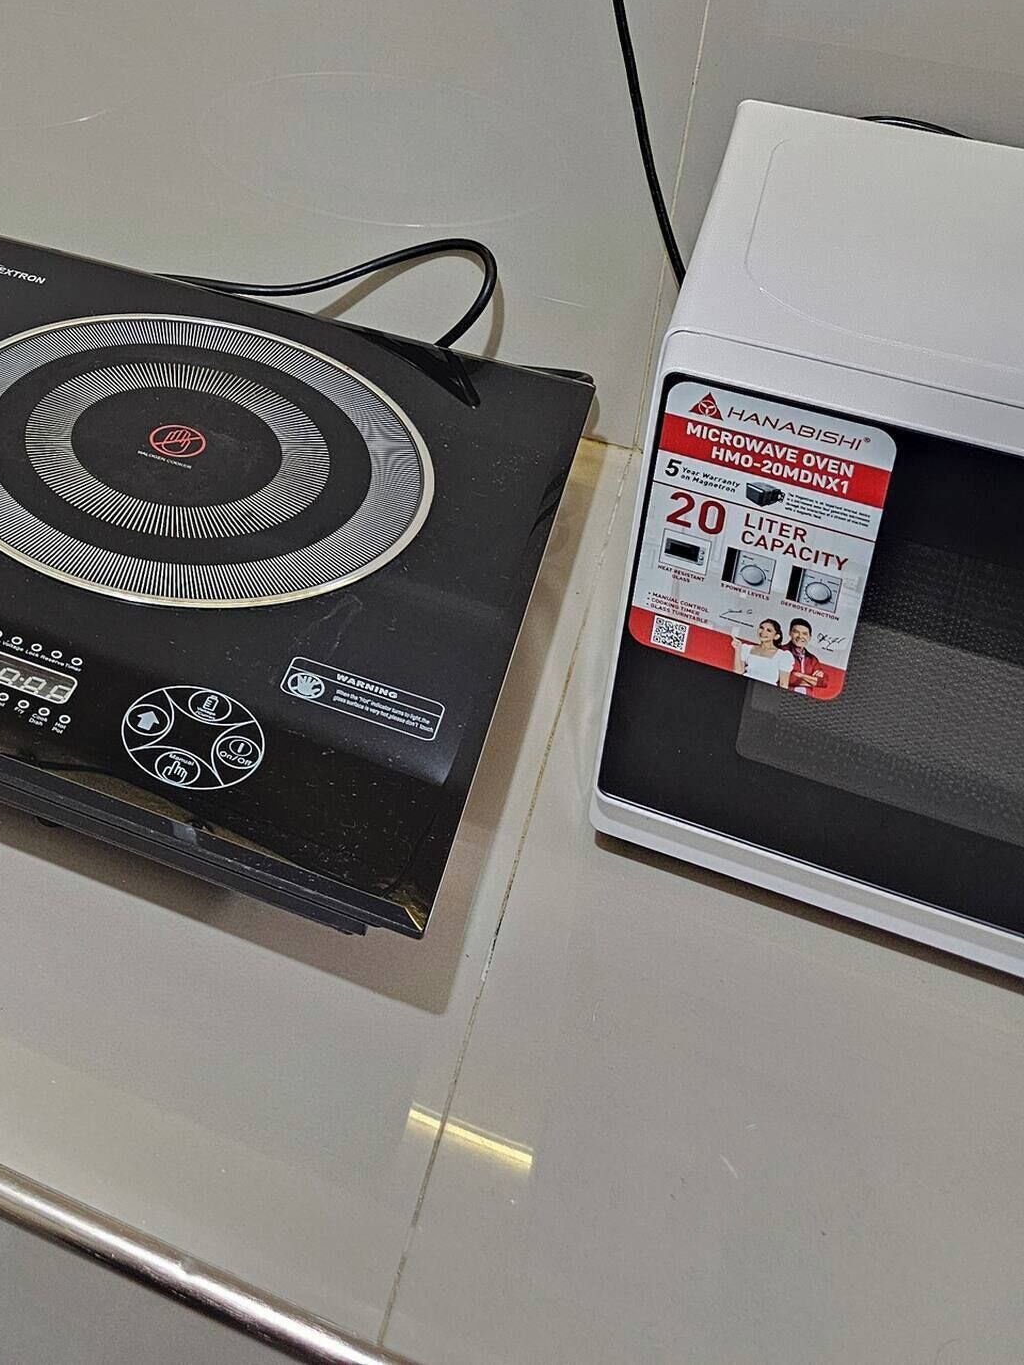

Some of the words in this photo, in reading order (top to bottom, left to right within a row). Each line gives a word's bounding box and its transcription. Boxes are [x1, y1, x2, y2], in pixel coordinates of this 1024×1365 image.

[727, 406, 863, 451] HANABISHI
[686, 422, 799, 463] MICROWAVE
[802, 451, 855, 478] OVEN
[665, 458, 682, 477] 5
[681, 466, 699, 476] Year
[702, 472, 741, 488] Warranty
[711, 446, 849, 495] HMO-20MDNX1
[692, 477, 736, 493] Magnetron
[666, 491, 726, 535] 20
[744, 513, 807, 543] LITER
[741, 530, 848, 571] CAPACITY
[658, 565, 673, 573] HEAT
[652, 592, 679, 604] MANUAL
[680, 600, 709, 613] CONTROL
[725, 584, 747, 594] POWER
[747, 590, 770, 601] LEVELS
[780, 600, 808, 613] DEFROST
[808, 608, 840, 621] FUNCTION
[336, 673, 398, 699] WARNING
[169, 753, 195, 767] Manual
[220, 750, 254, 766] On/Off
